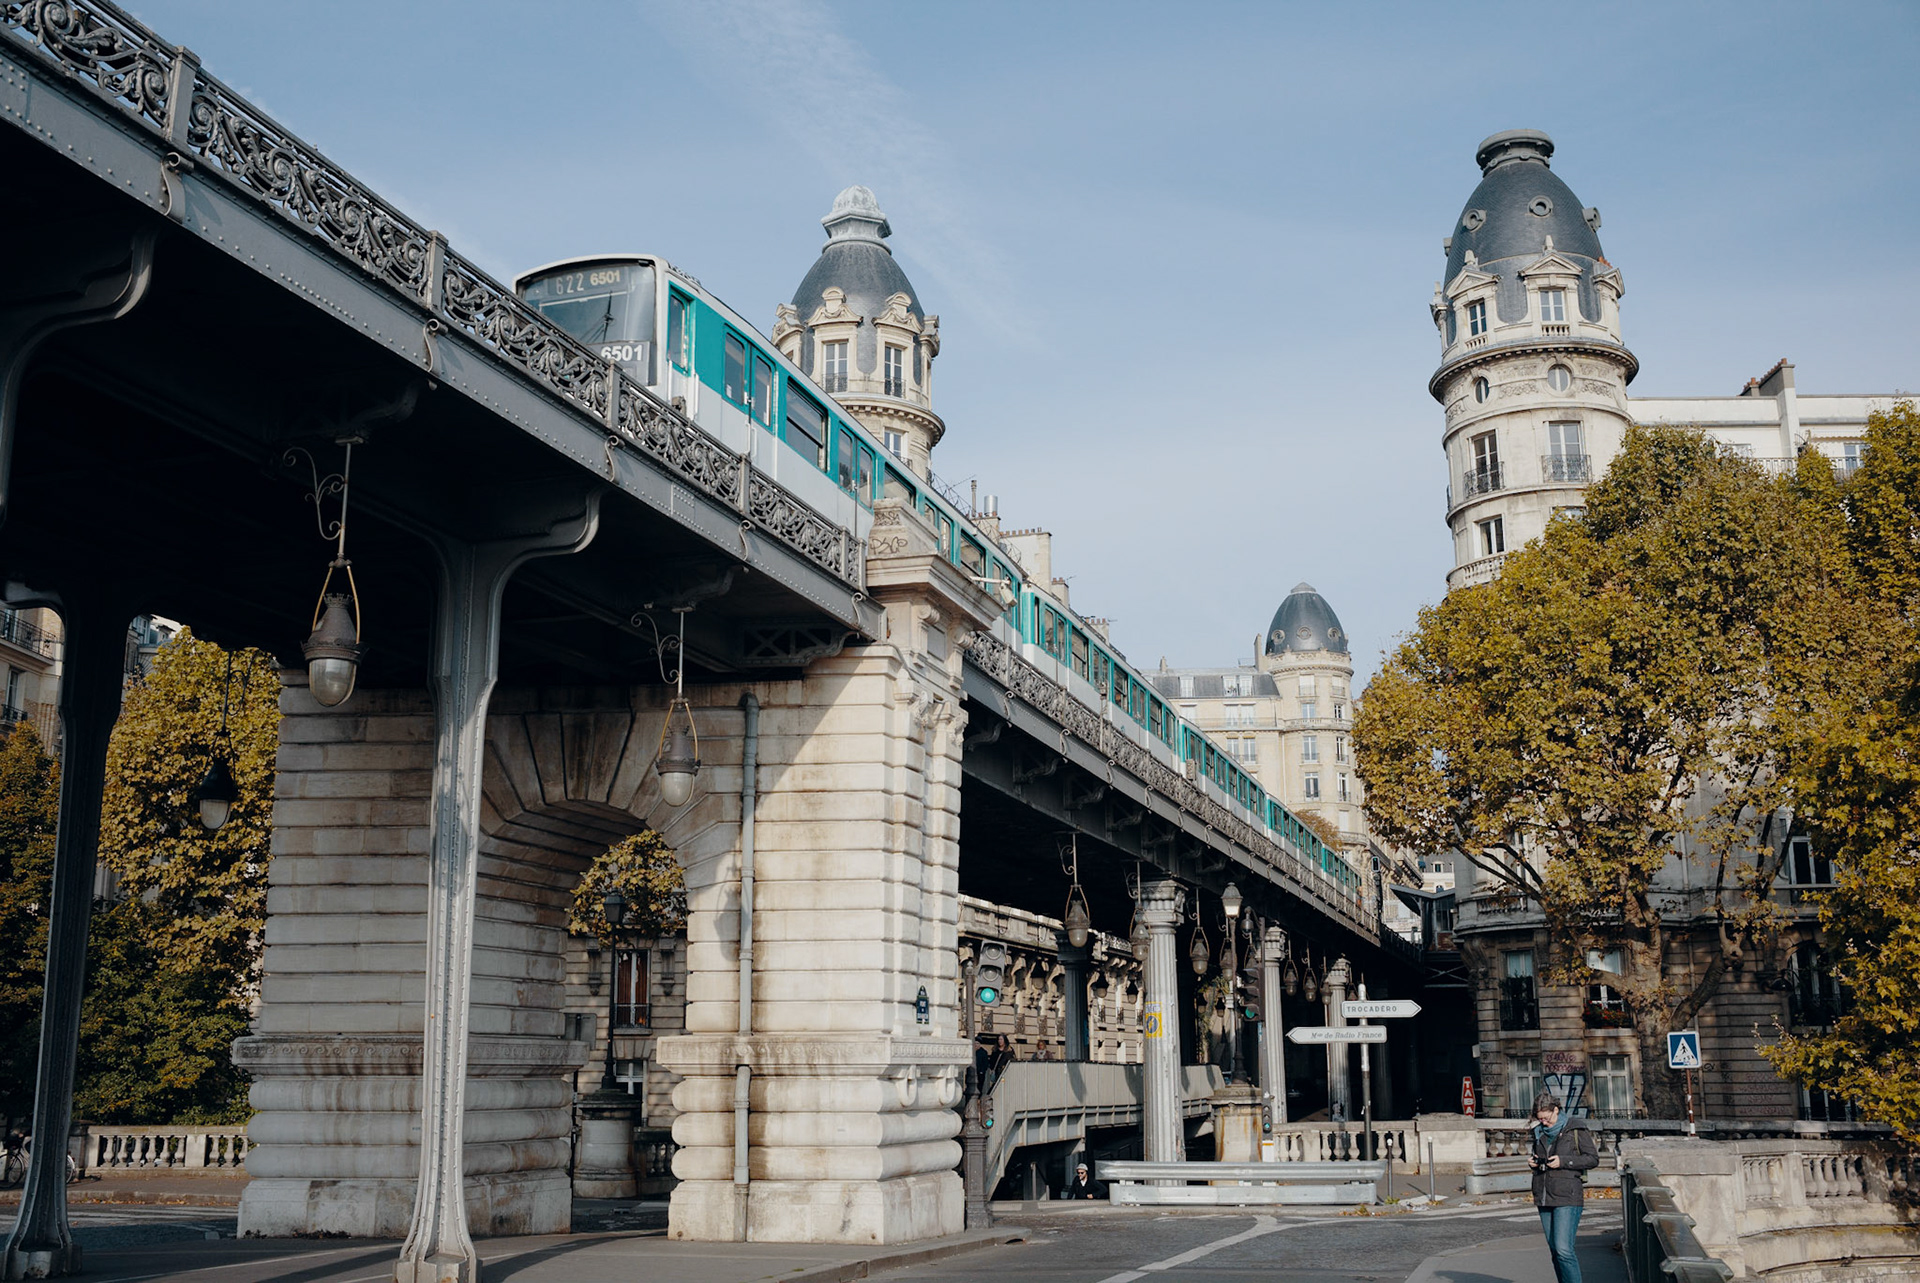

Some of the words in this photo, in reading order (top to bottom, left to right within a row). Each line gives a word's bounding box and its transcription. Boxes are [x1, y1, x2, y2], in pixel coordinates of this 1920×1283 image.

[556, 273, 584, 294] 622
[590, 270, 620, 286] 6501
[601, 345, 642, 361] 6501
[1335, 1031, 1355, 1039] Radio
[1357, 1031, 1382, 1039] France
[1464, 1081, 1474, 1114] TABA
